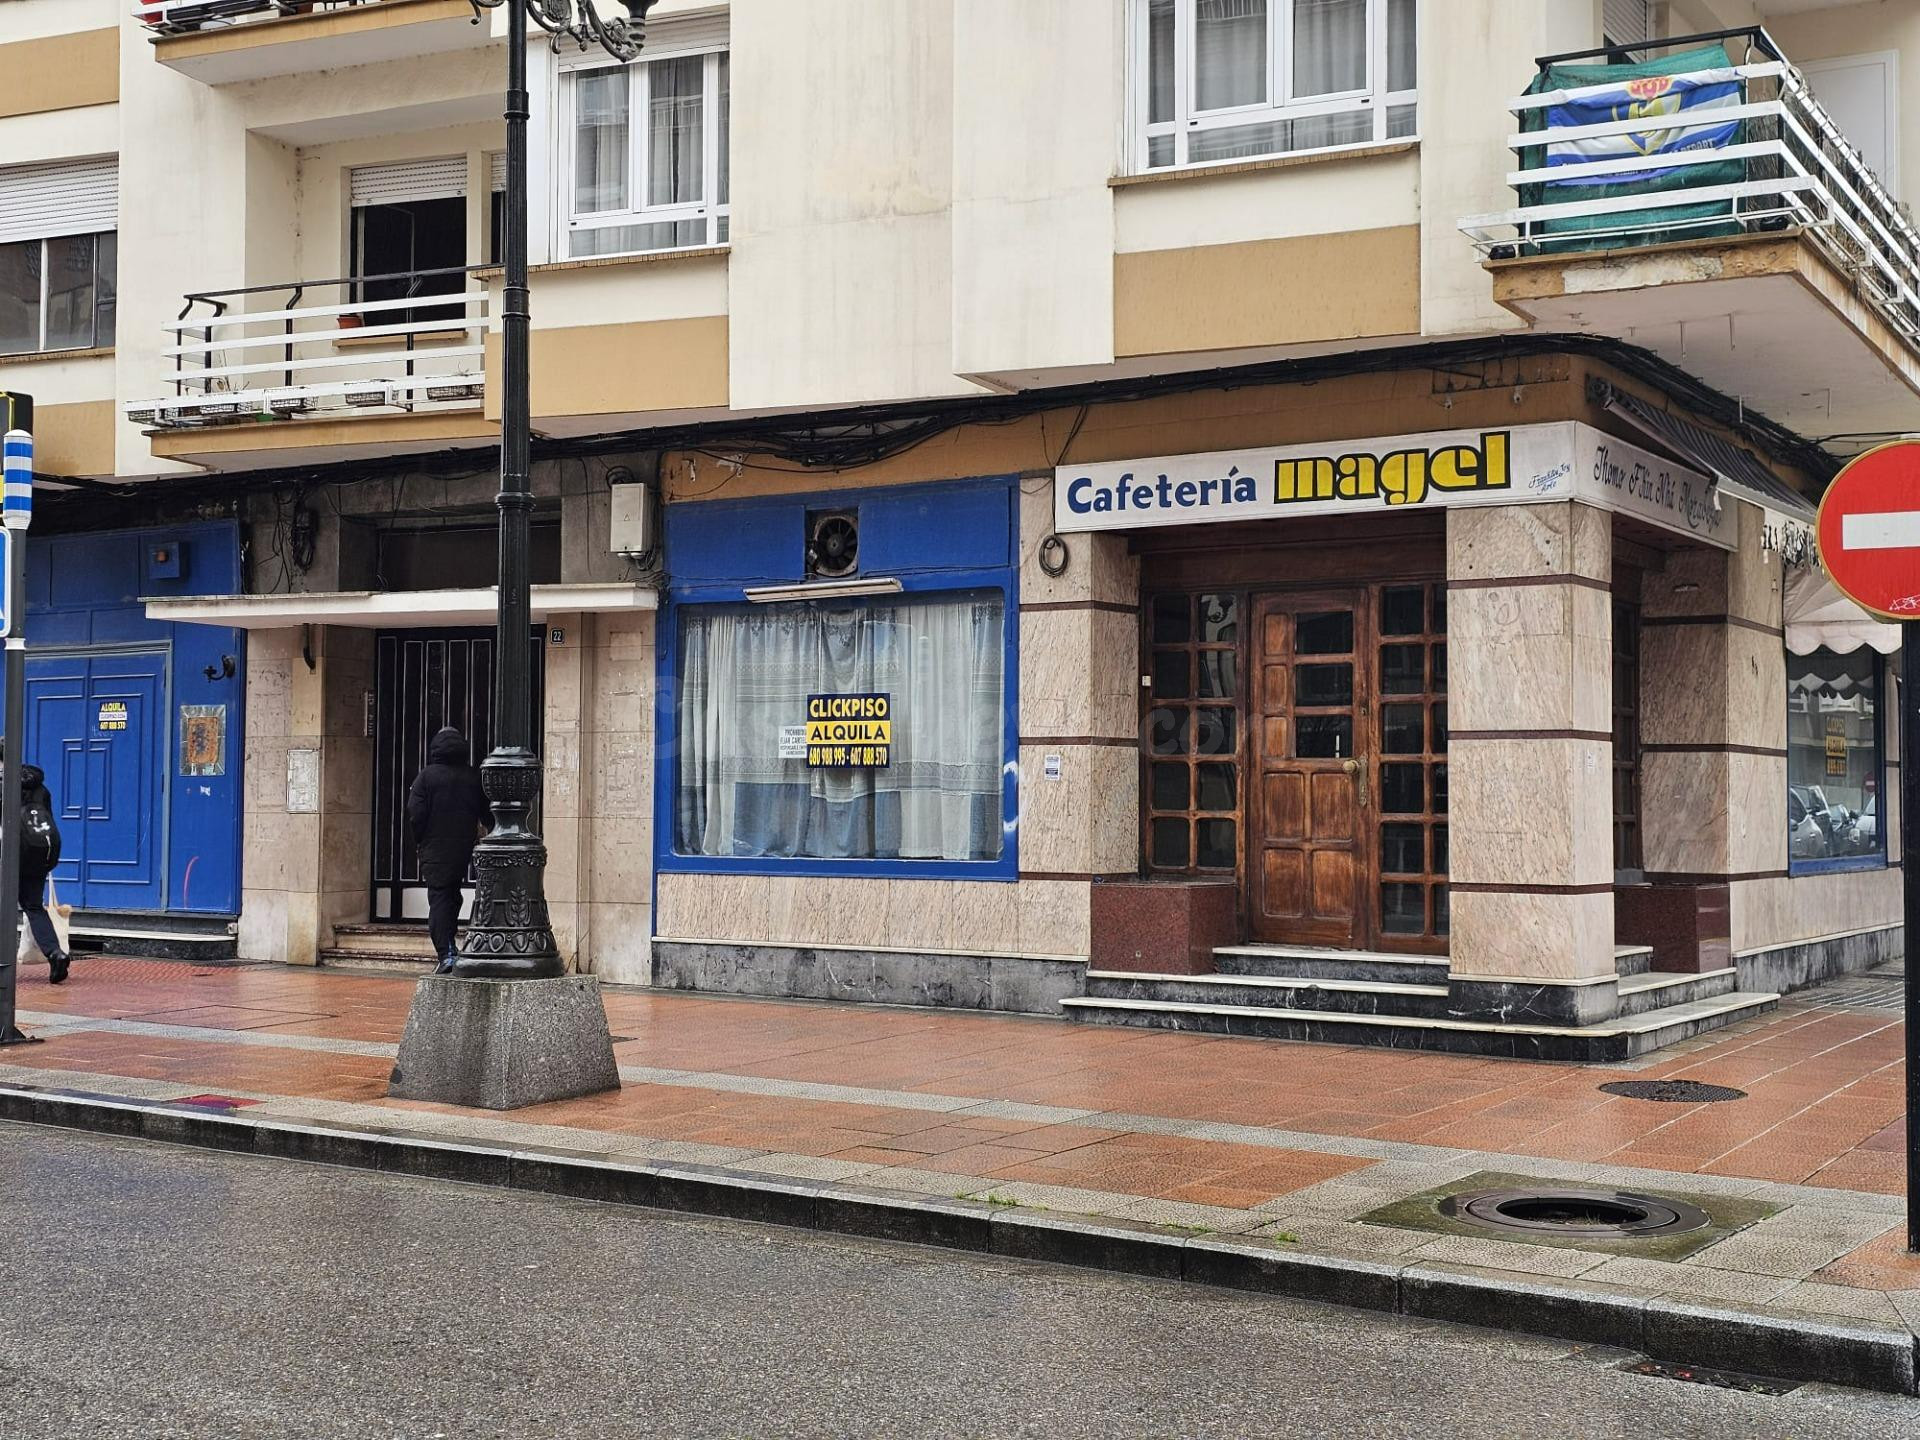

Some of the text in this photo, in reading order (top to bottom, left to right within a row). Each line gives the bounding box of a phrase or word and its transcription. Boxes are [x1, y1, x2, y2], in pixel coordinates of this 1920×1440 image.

[1067, 431, 1511, 514] Cafetería magel
[554, 631, 562, 641] 22
[809, 697, 888, 718] CLICKPISO
[811, 725, 886, 741] ALQUILA
[808, 746, 821, 766] 680
[834, 746, 846, 766] 995
[875, 746, 888, 766] 570
